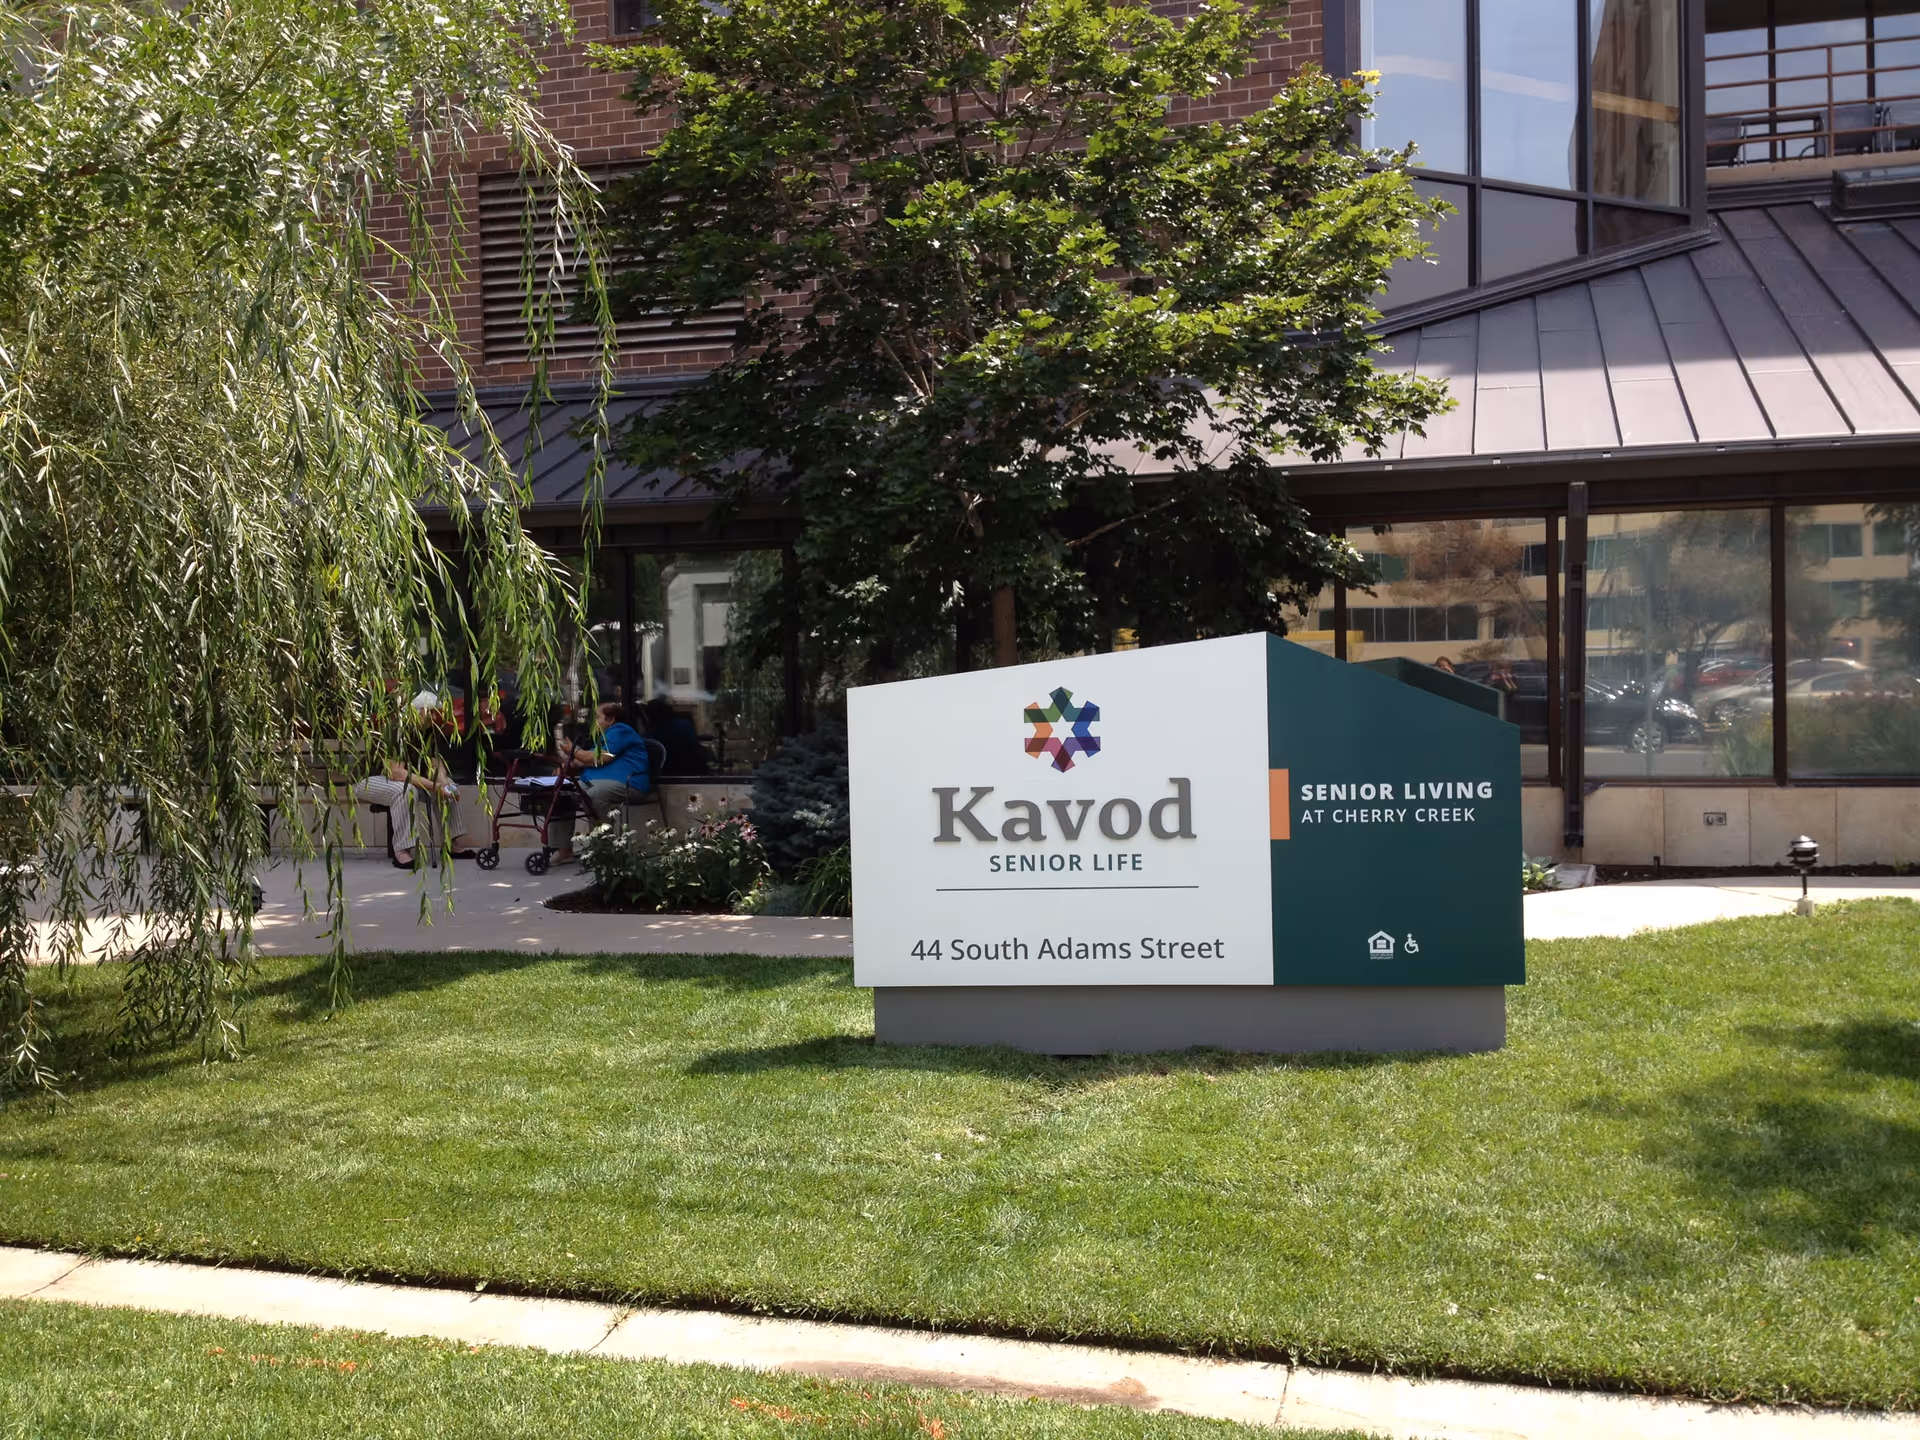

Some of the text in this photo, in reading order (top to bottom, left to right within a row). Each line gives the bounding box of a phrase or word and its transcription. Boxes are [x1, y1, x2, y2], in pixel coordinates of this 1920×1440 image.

[1301, 781, 1493, 801] SENIOR LIVING
[932, 777, 1198, 844] Kavod
[1301, 807, 1475, 824] AT CHERRY CREEK
[989, 853, 1143, 873] SENIOR LIFE
[910, 936, 1225, 961] 44 South Adams Street
